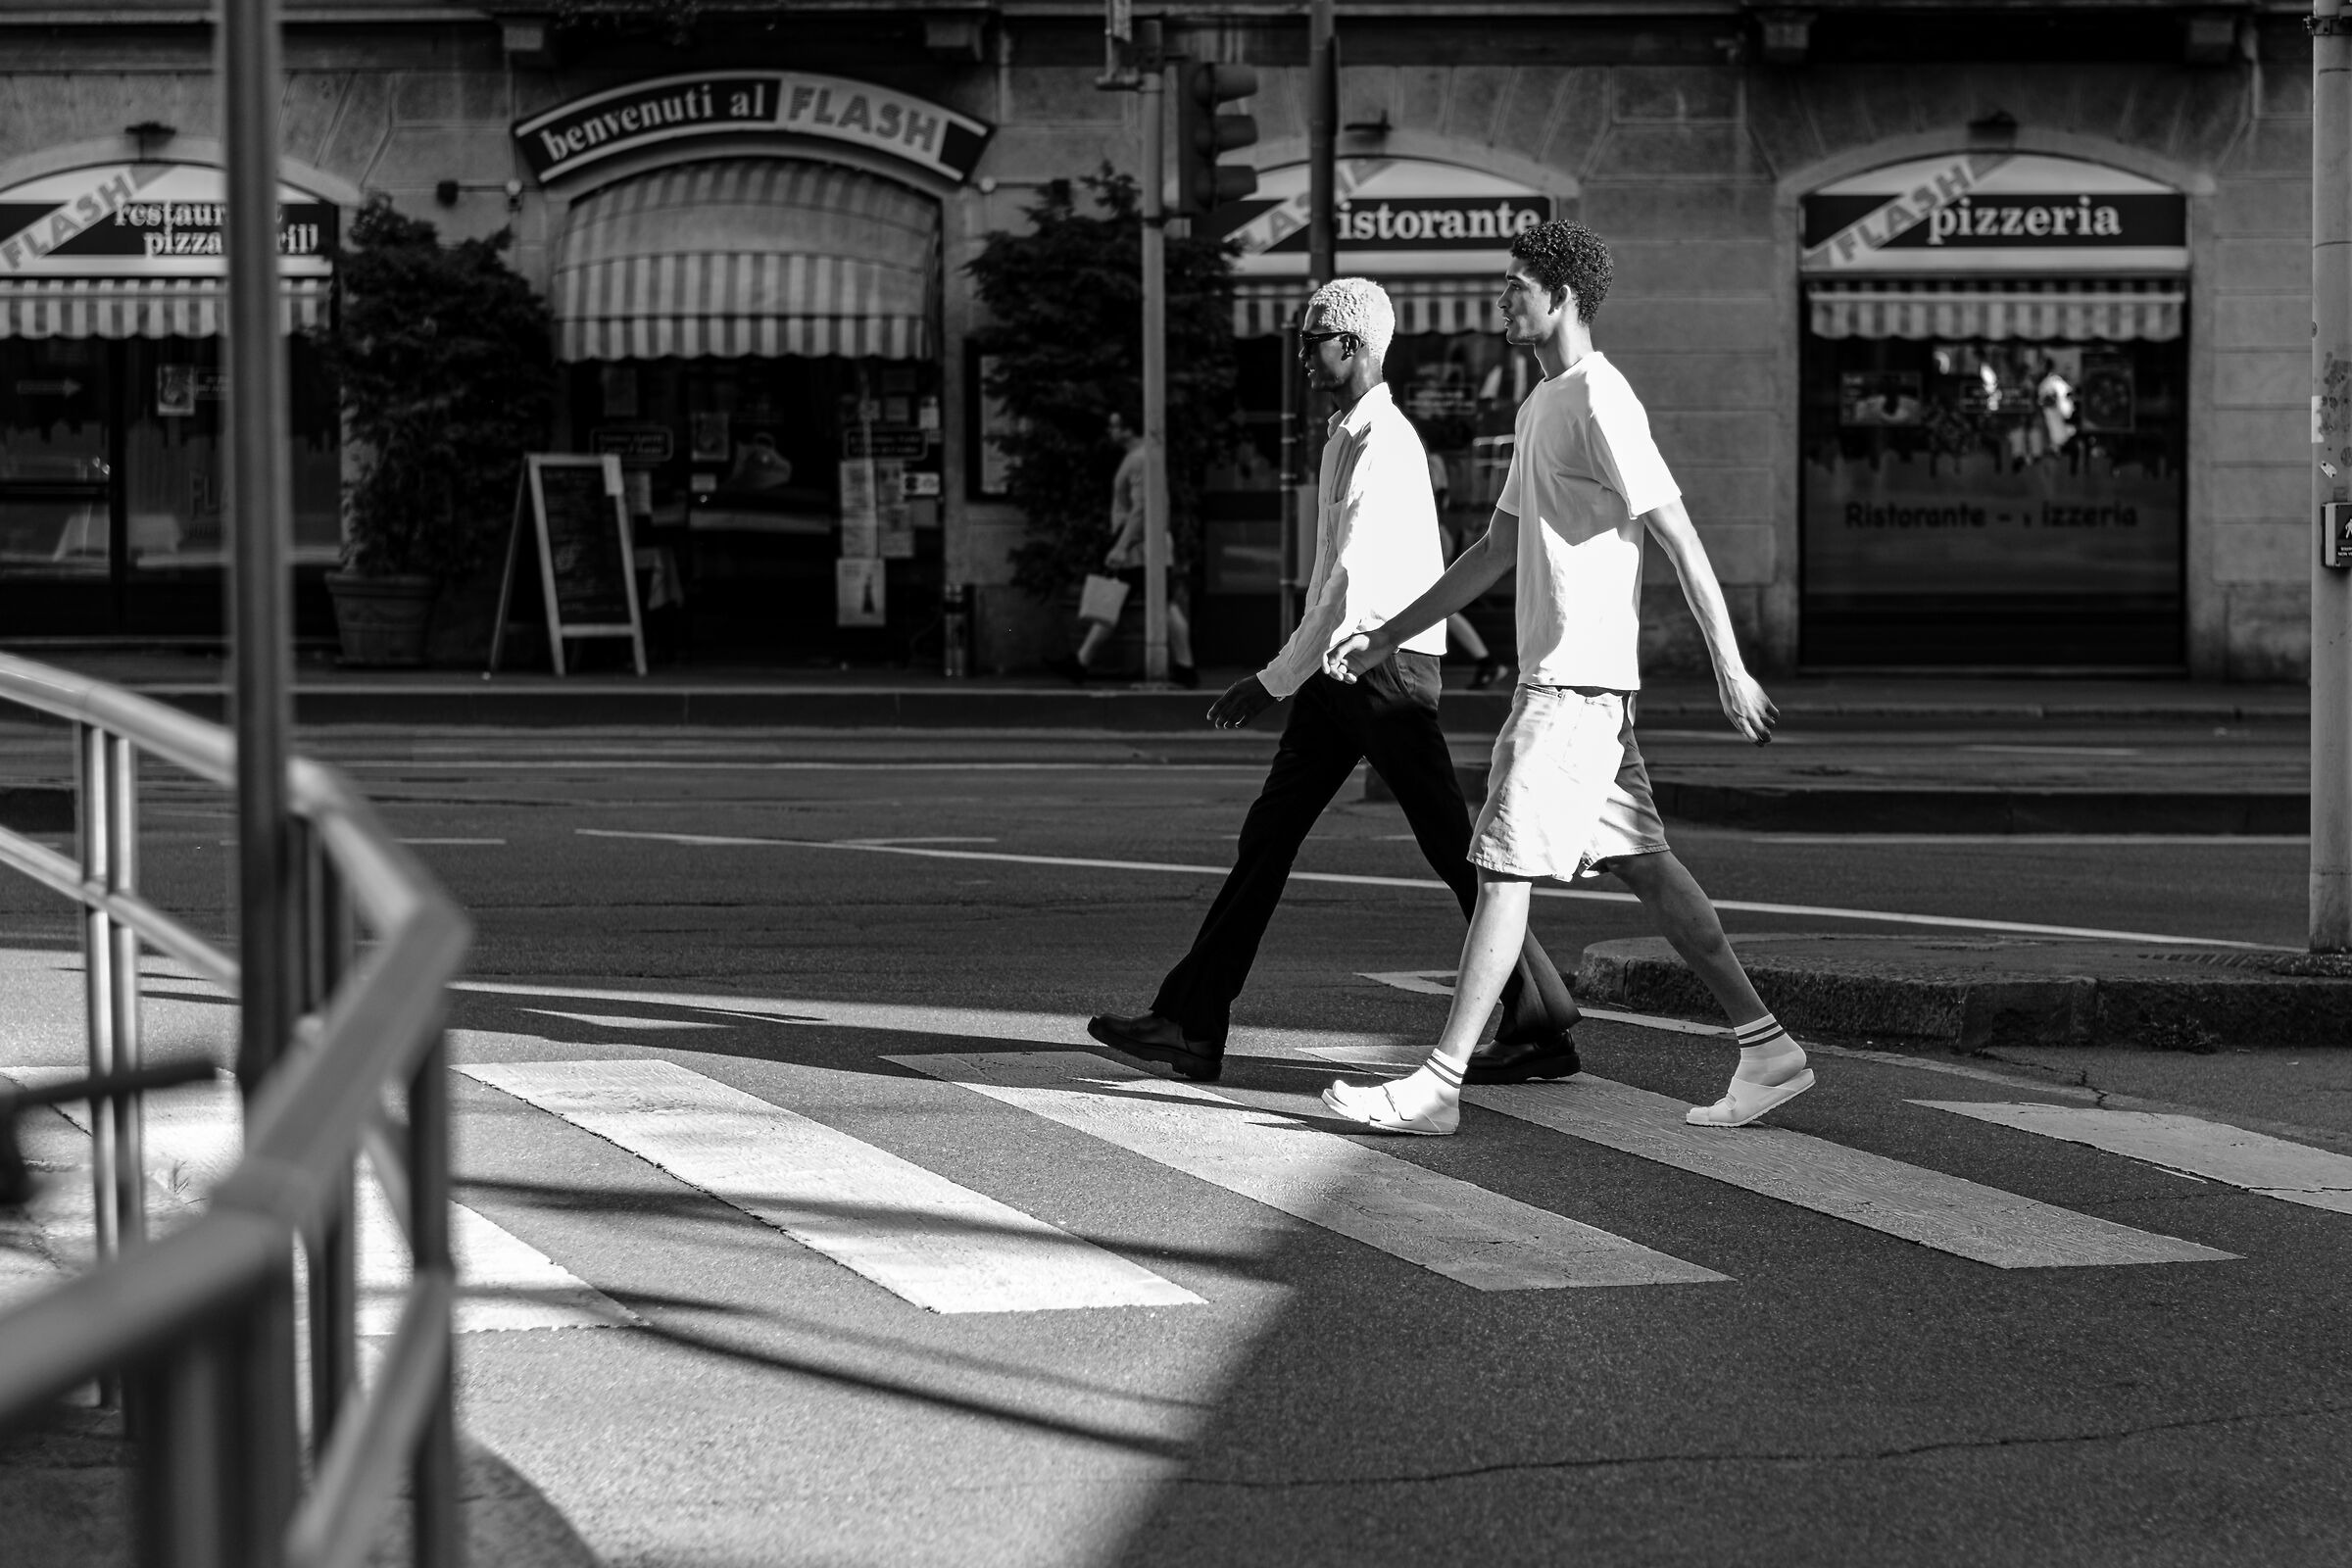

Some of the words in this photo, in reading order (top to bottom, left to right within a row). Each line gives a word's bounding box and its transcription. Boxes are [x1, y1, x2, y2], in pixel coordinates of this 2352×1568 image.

[540, 82, 712, 162] benvenuti
[730, 83, 765, 117] al
[787, 85, 941, 152] FLASH
[2, 172, 133, 272] FLASH
[114, 199, 282, 227] restaurt
[1335, 199, 1543, 241] istorante
[1835, 163, 1971, 265] FLASH
[1926, 195, 2123, 246] pizzeria
[143, 223, 223, 258] pizza
[1844, 500, 1987, 529] Ristorante
[2023, 500, 2138, 529] izzeria
